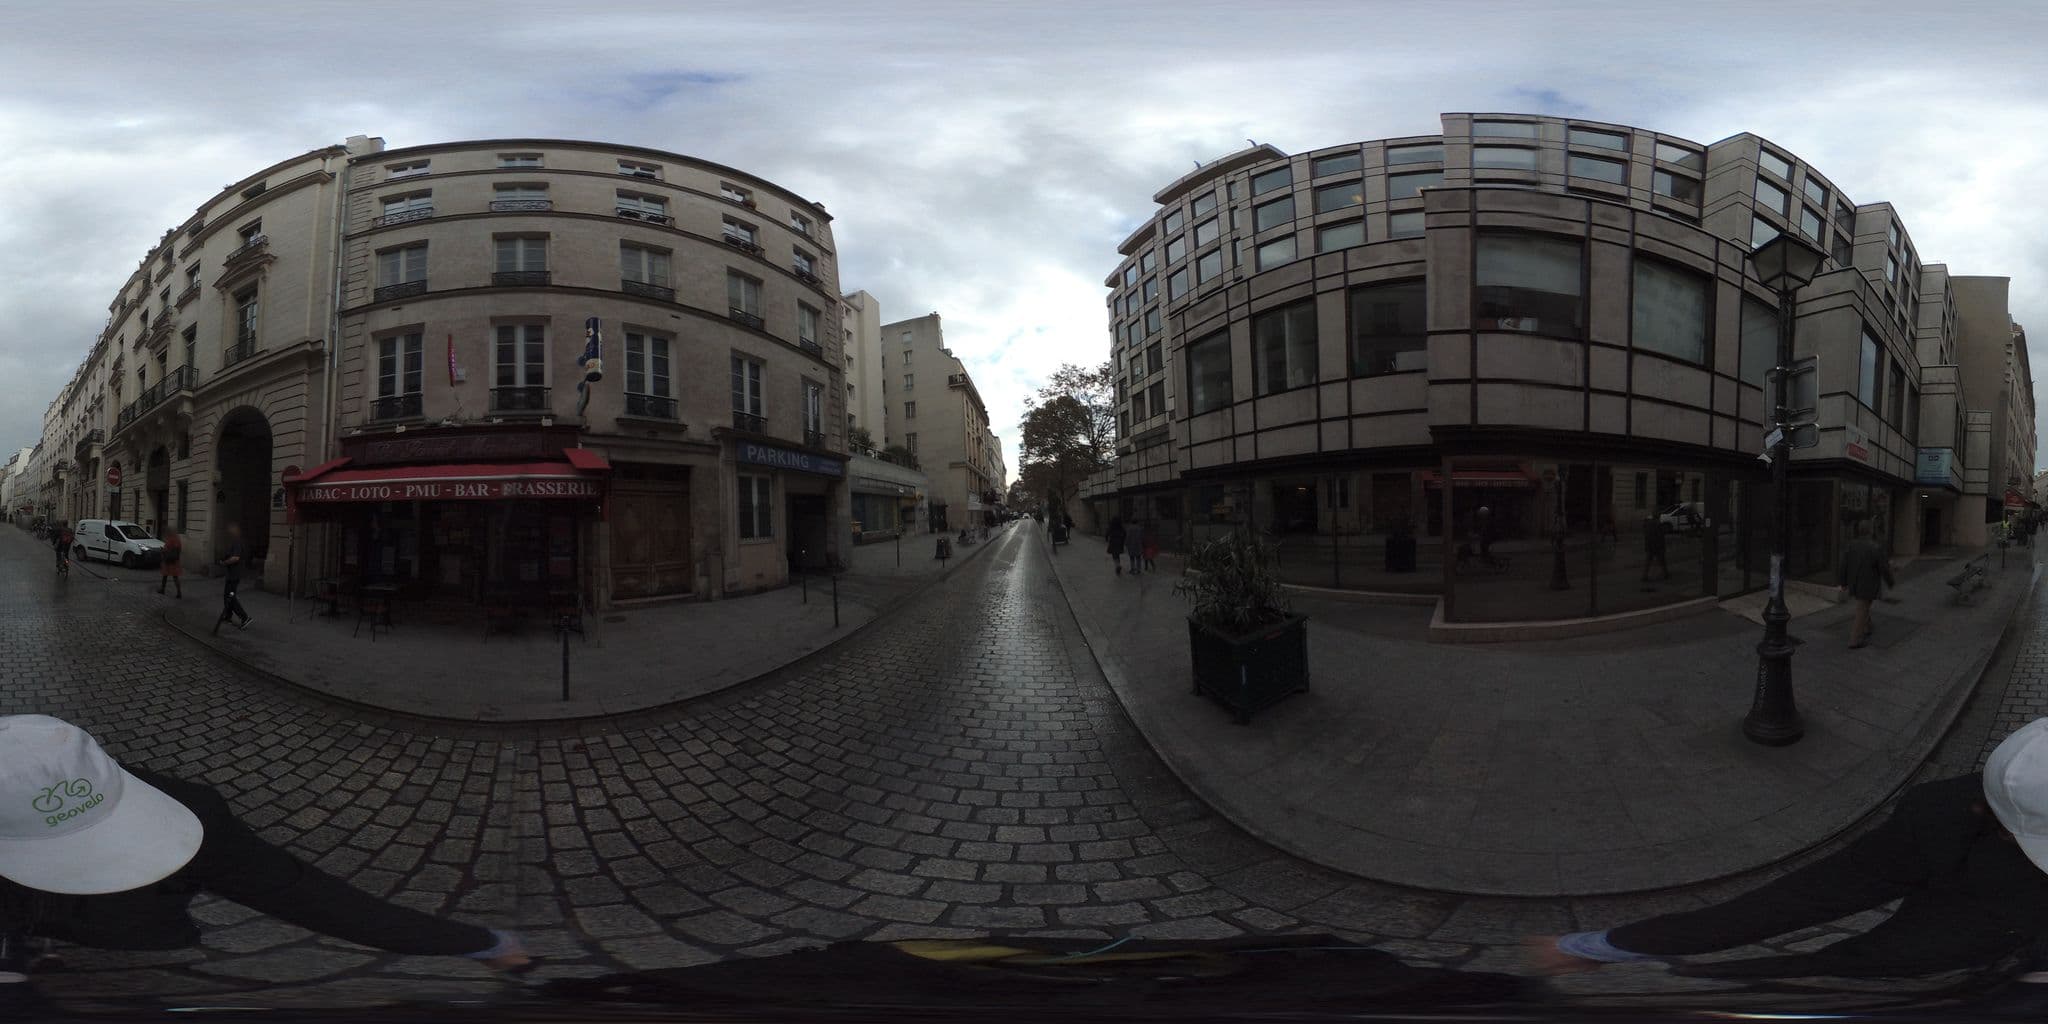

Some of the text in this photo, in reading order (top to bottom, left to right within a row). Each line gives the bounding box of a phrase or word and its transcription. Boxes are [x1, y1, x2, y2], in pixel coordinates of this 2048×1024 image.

[747, 446, 809, 468] PARKING
[351, 486, 391, 498] LOTO
[406, 484, 441, 497] PMU
[455, 483, 489, 496] BAR
[502, 481, 598, 496] BRASSERIE
[45, 791, 104, 827] geovelo
